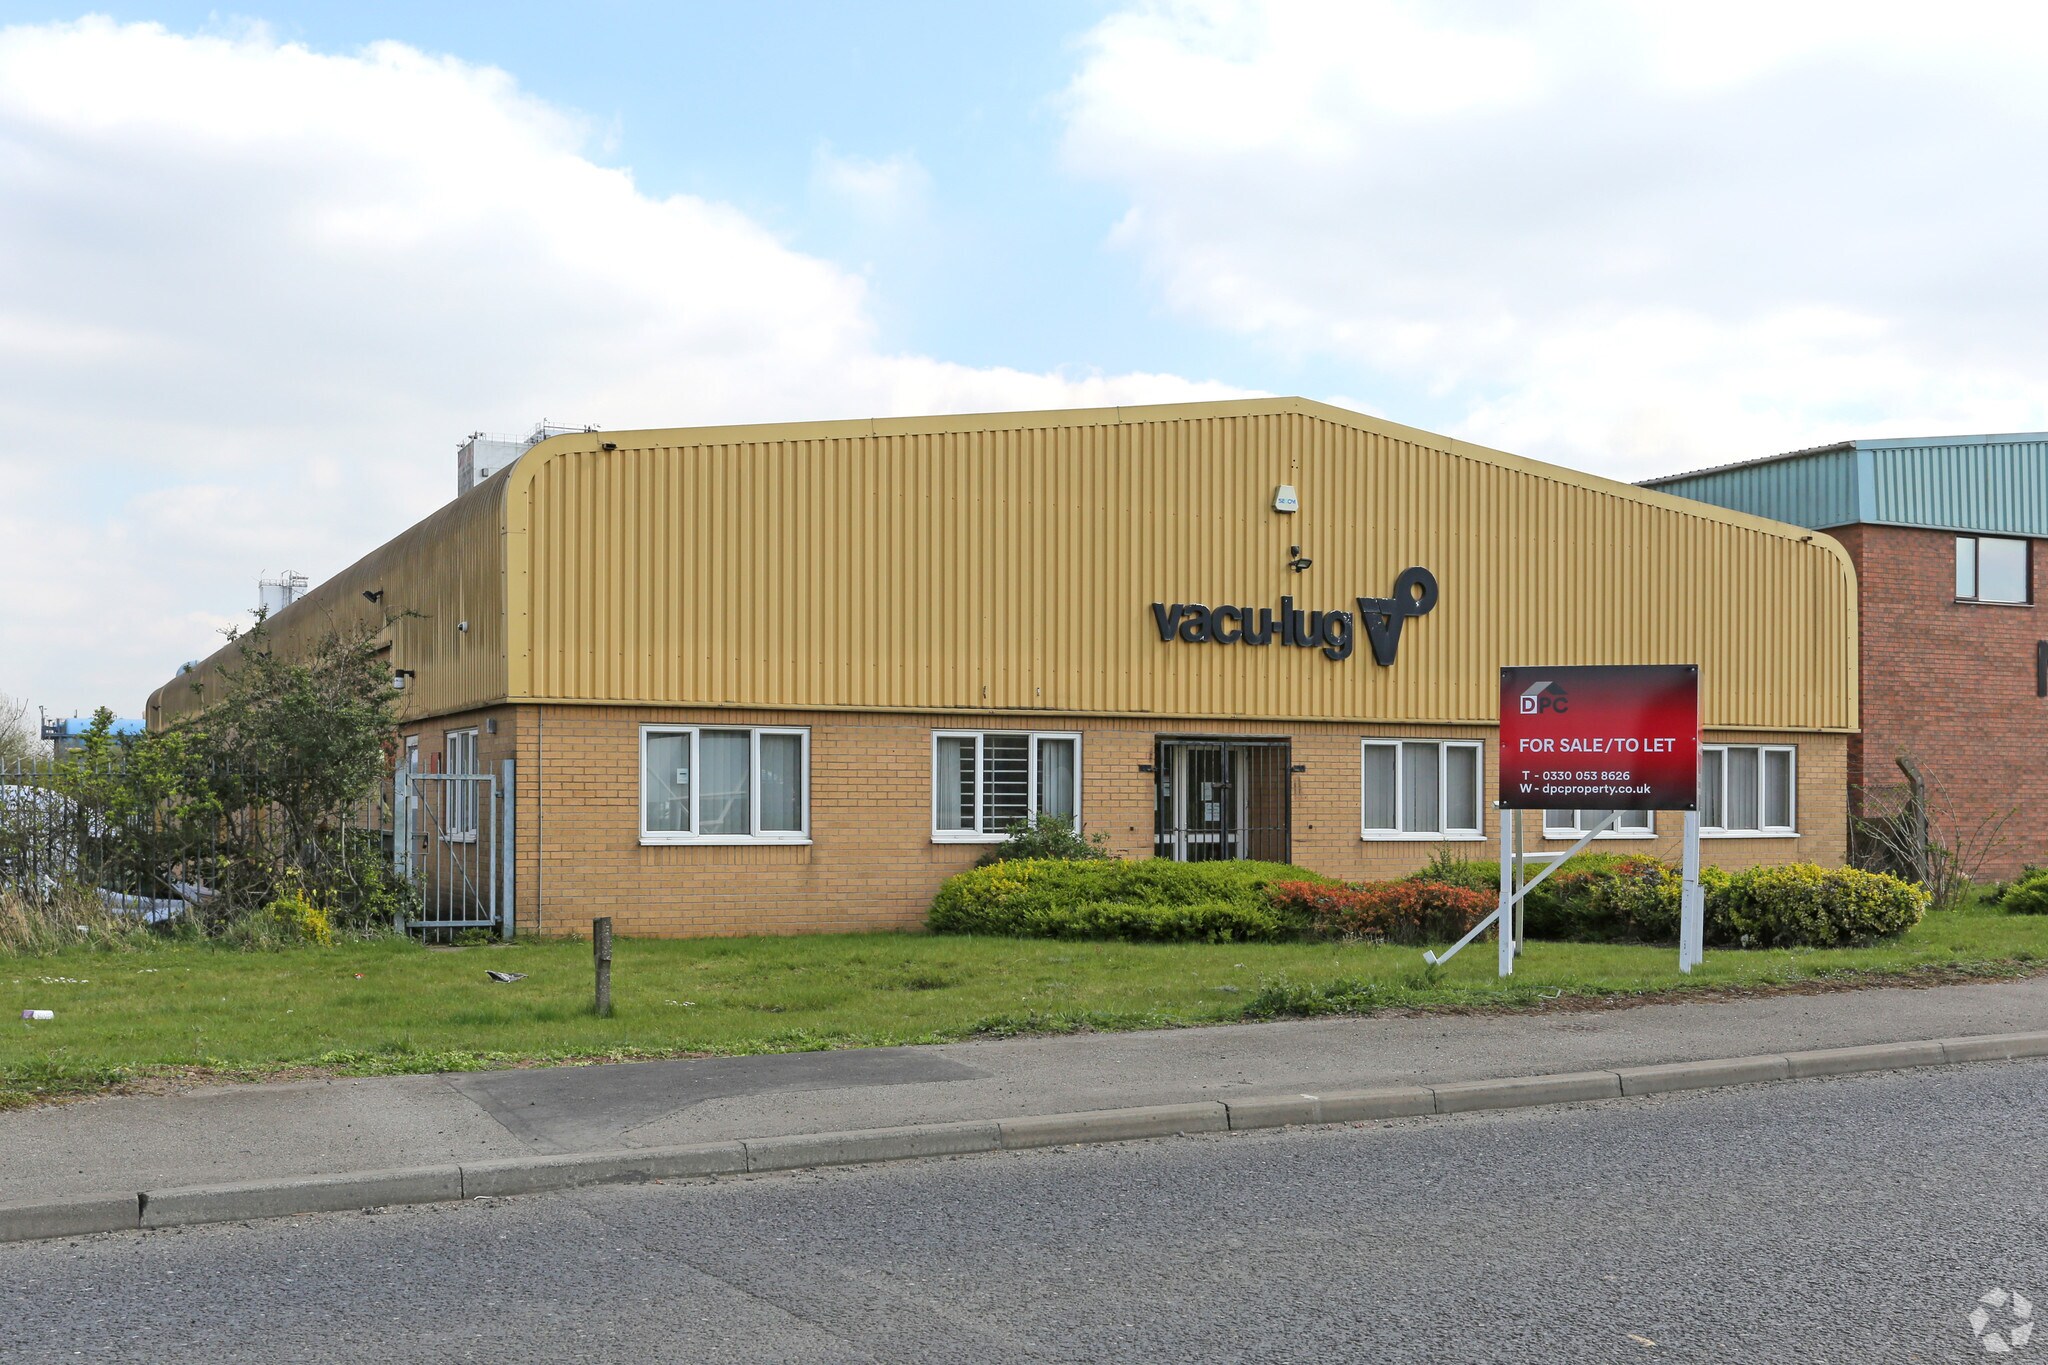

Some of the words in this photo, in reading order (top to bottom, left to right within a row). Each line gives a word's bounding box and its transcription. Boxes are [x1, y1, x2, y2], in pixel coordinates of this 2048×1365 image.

[1152, 595, 1354, 661] vacu-lug
[1521, 696, 1568, 714] DPC
[1519, 738, 1555, 753] FOR
[1559, 738, 1639, 754] SALE/TO
[1643, 738, 1676, 753] LET
[1522, 770, 1530, 780] T
[1542, 771, 1572, 781] 0330
[1575, 771, 1597, 781] 053
[1601, 771, 1630, 781] 8626
[1519, 783, 1532, 793] W
[1542, 783, 1651, 796] dpcproperty.co.uk
